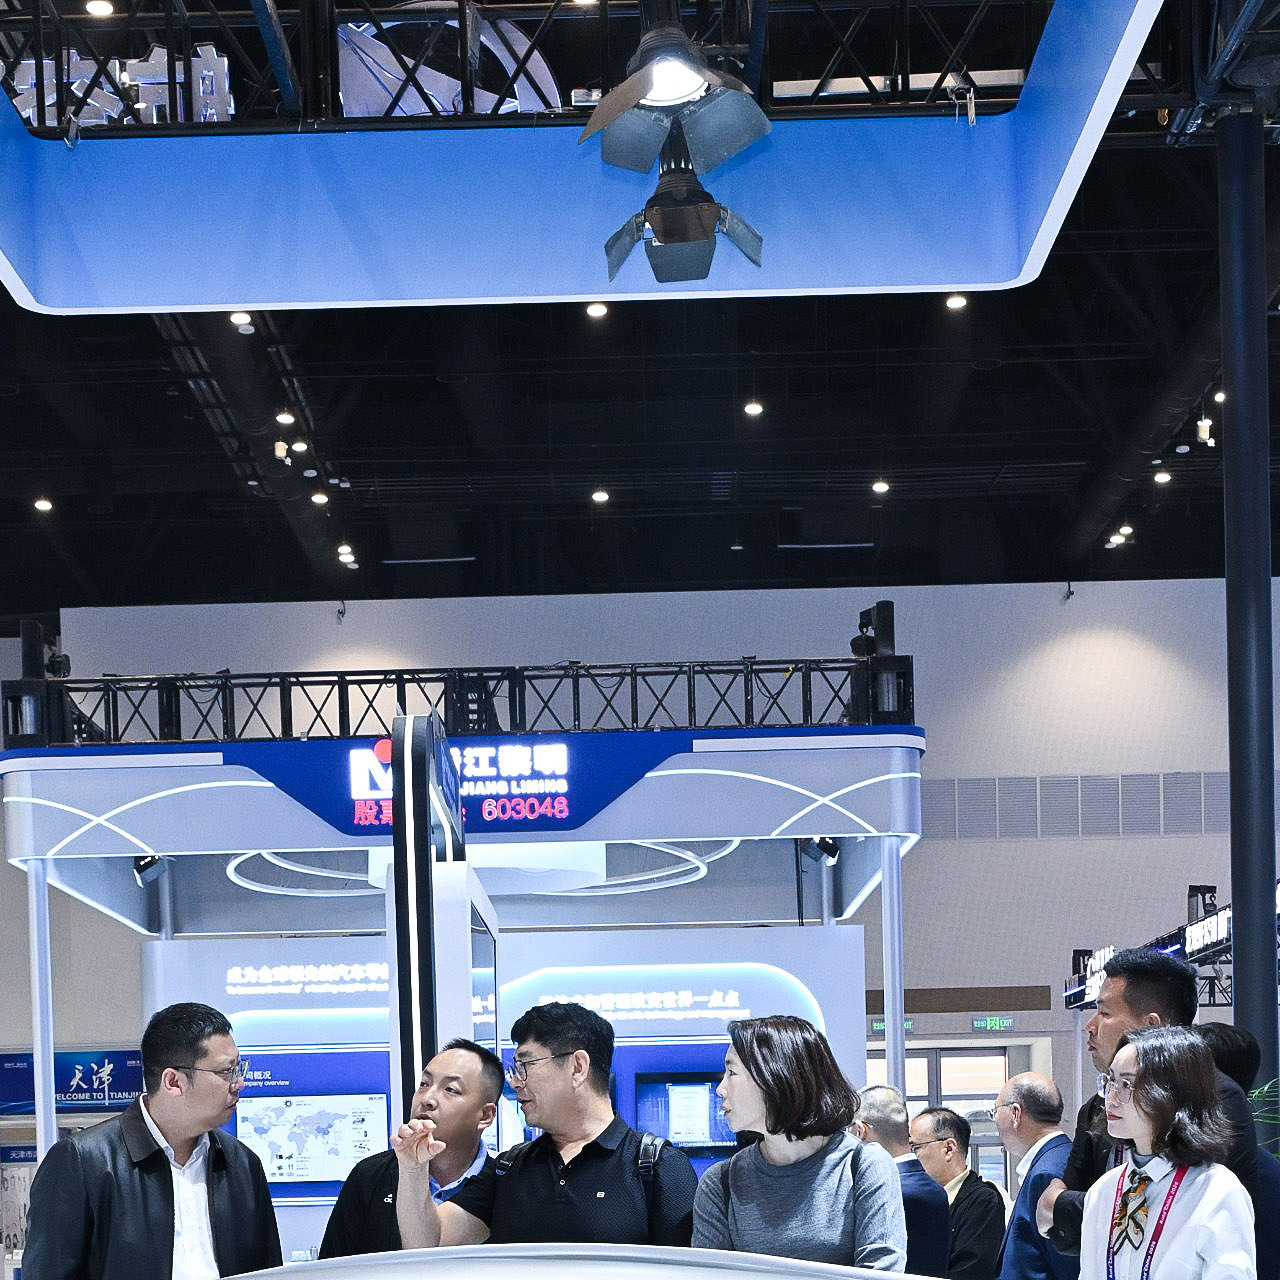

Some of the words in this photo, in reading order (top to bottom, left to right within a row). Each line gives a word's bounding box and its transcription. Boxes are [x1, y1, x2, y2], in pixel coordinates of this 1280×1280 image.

[460, 781, 509, 795] JIANG
[482, 797, 569, 821] 603048
[70, 1058, 114, 1105] 天津
[244, 1070, 271, 1080] 司概况
[92, 1092, 103, 1100] TO
